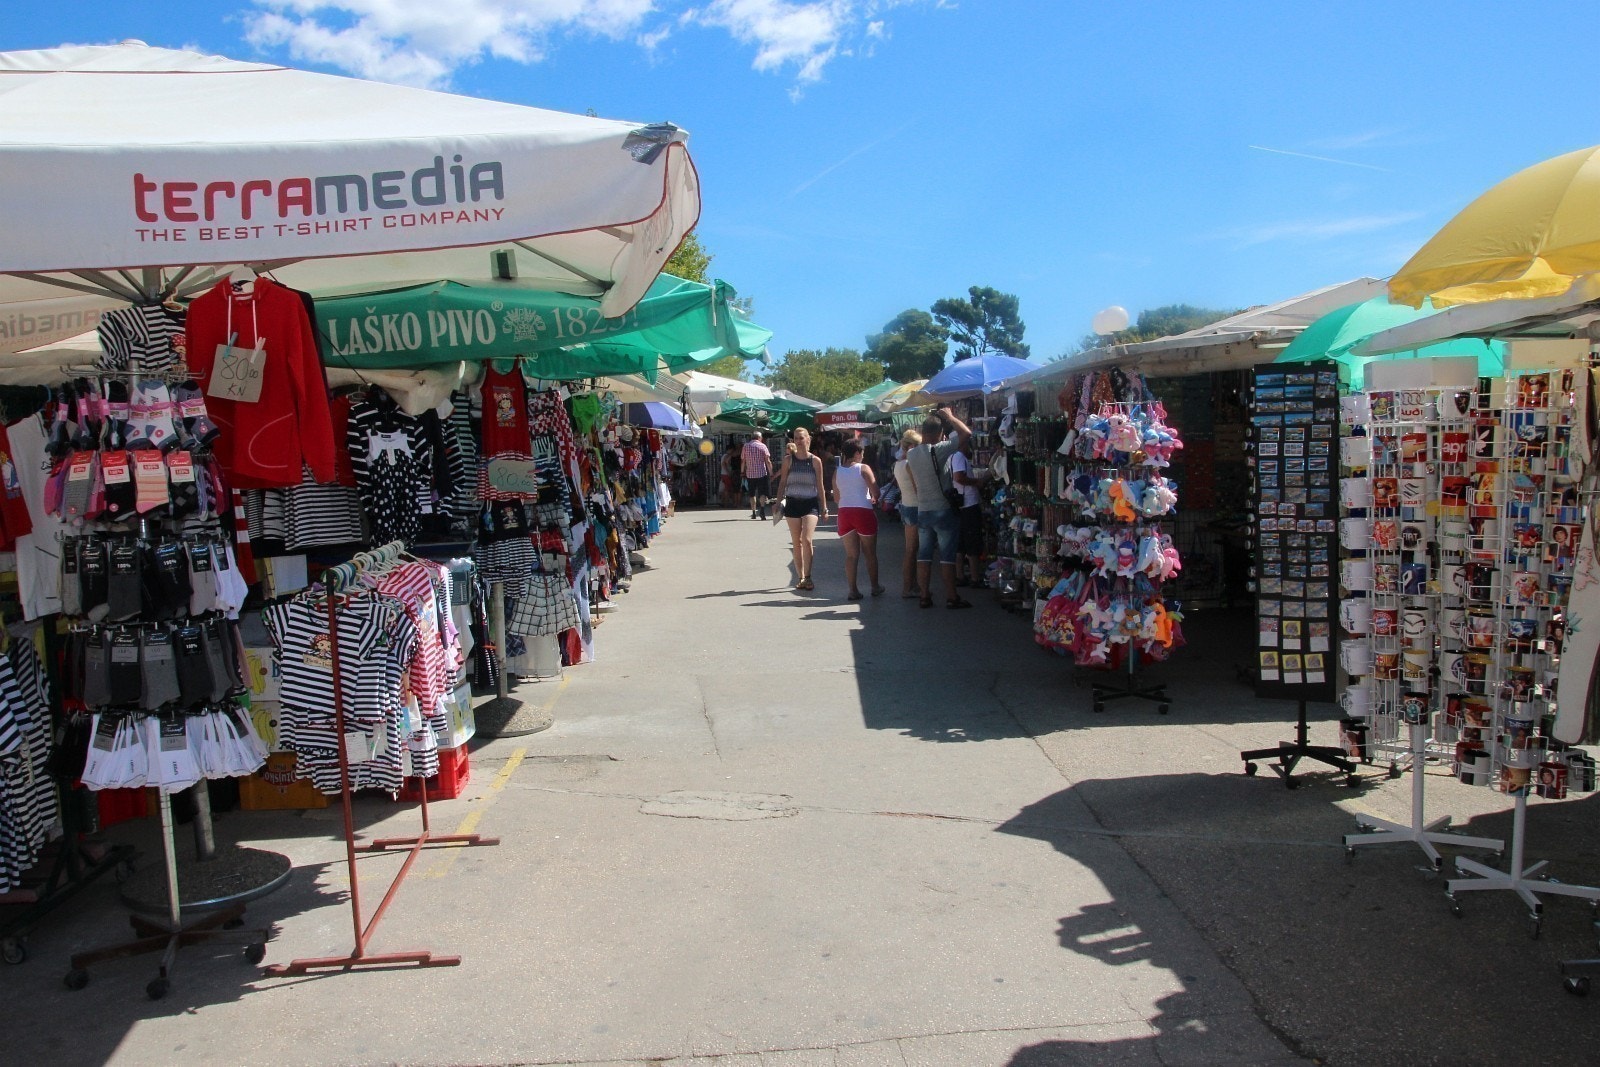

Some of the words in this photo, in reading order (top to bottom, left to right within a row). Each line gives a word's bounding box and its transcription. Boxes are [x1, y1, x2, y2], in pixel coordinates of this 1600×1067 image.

[135, 228, 186, 242] THE
[199, 226, 265, 241] BEST
[273, 217, 373, 236] T-SHIRT
[383, 207, 505, 229] COMPANY
[328, 306, 422, 356] LAŠKO
